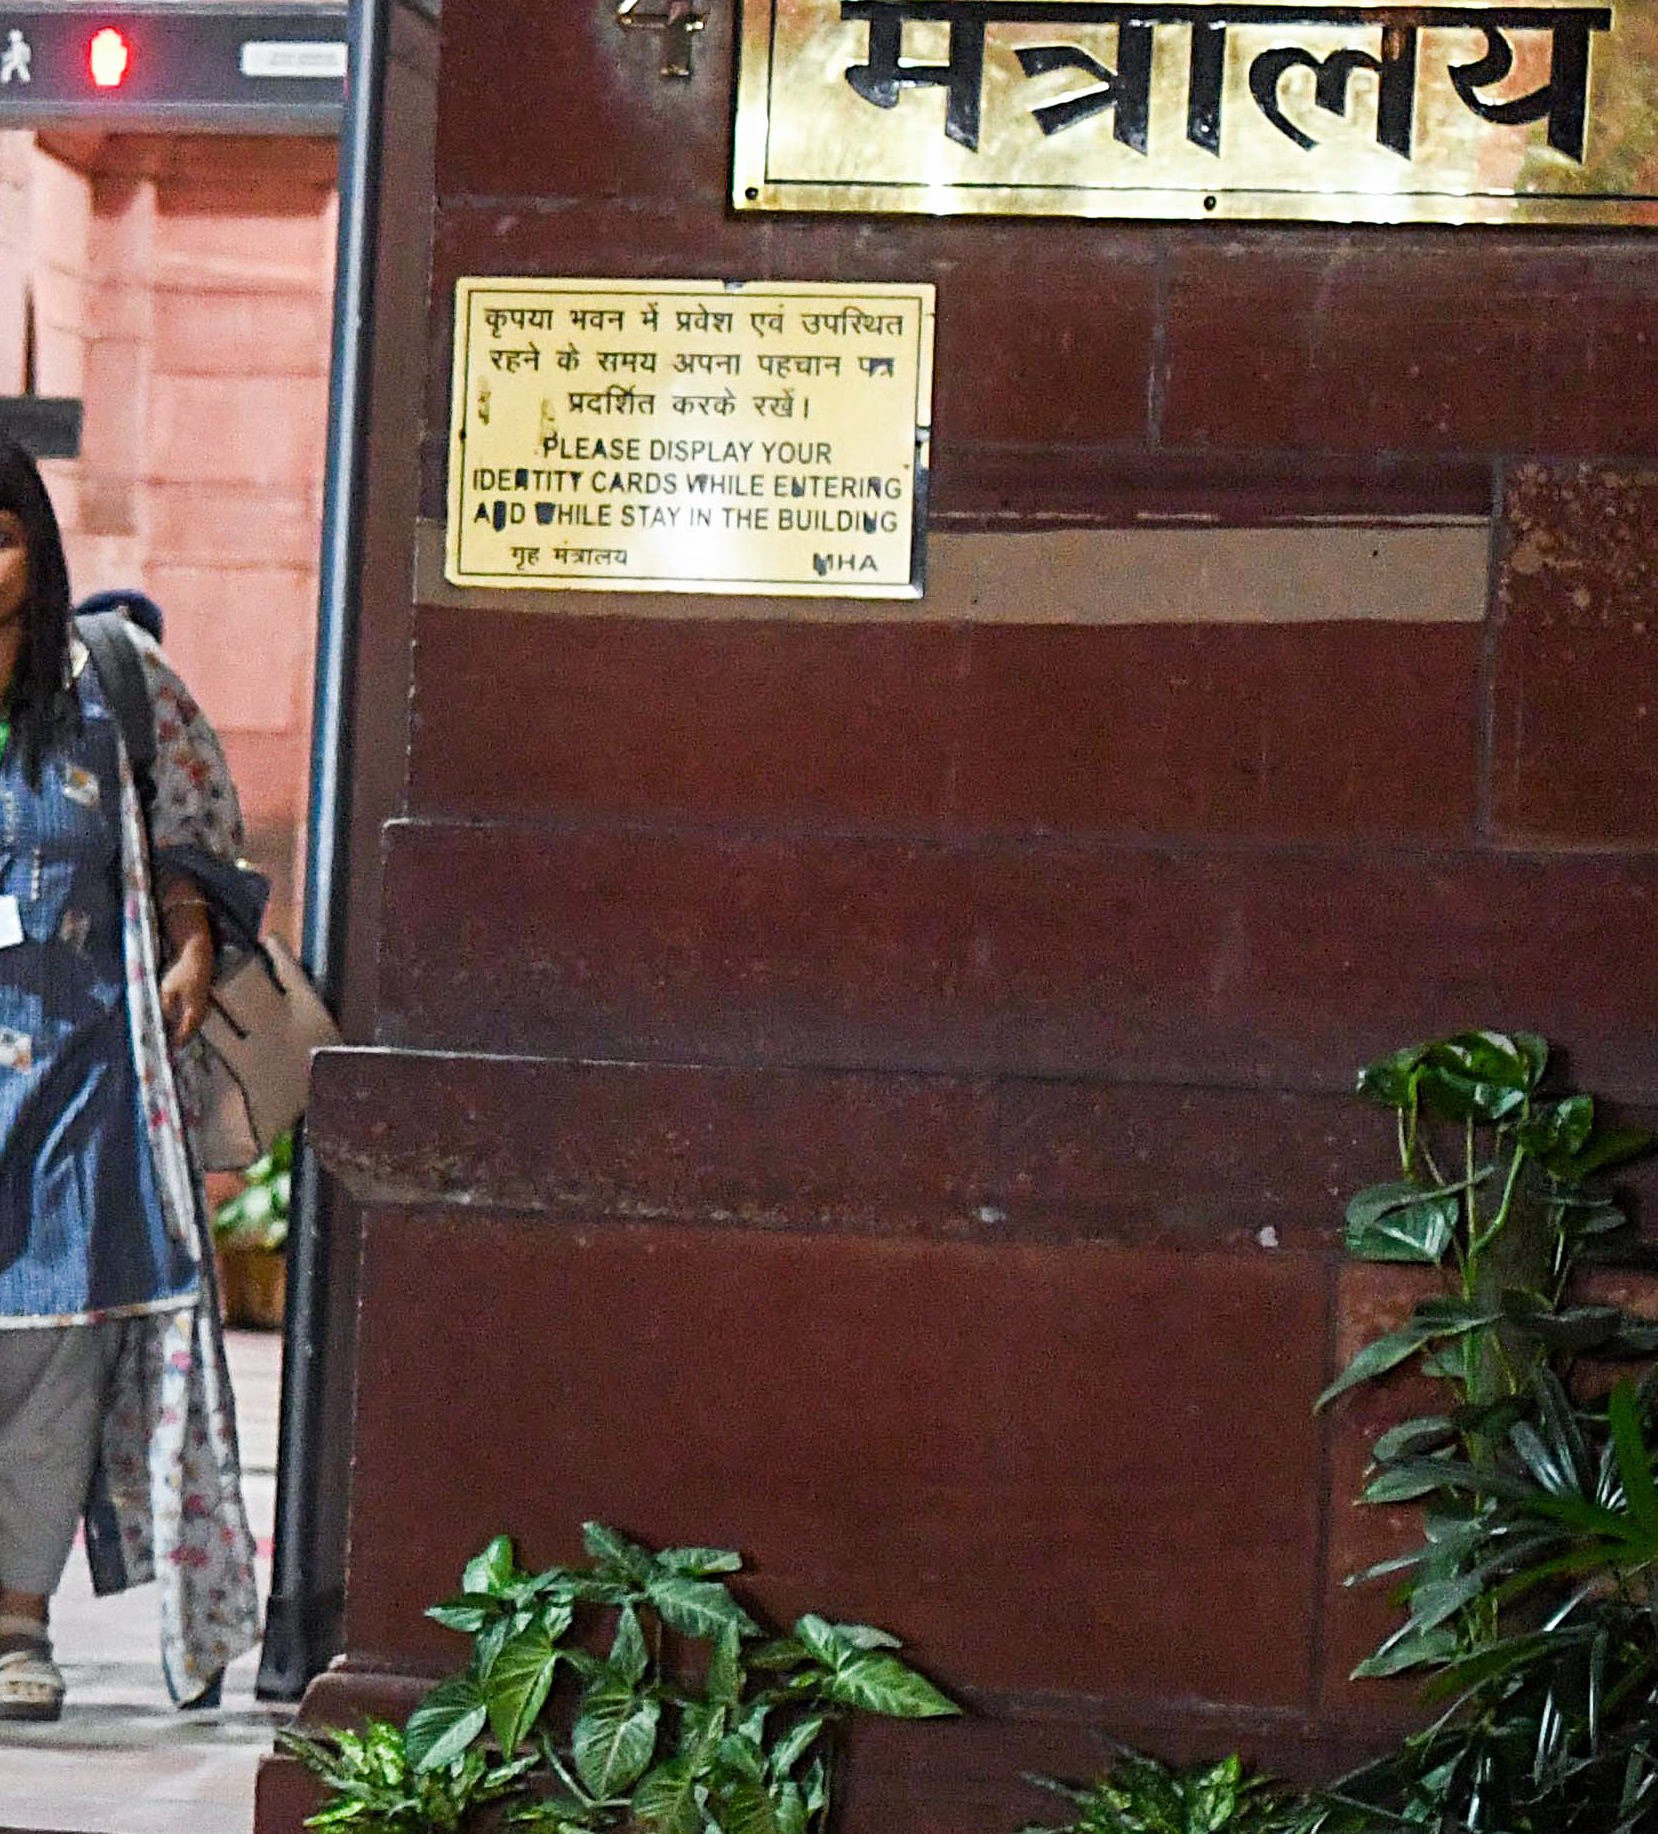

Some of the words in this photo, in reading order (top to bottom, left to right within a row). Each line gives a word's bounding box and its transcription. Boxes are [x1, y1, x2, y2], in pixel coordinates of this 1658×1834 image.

[484, 308, 553, 338] कृपया
[570, 310, 625, 331] भवन
[641, 302, 659, 331] में
[675, 303, 733, 333] प्रवेश
[750, 304, 783, 337] एवं
[800, 306, 903, 336] उपस्थित
[490, 342, 540, 372] रहने
[556, 342, 580, 371] के
[597, 352, 657, 373] समय
[673, 354, 740, 375] अपना
[757, 354, 841, 378] पहचान
[568, 383, 655, 414] प्रदर्शित
[672, 387, 736, 416] करके
[543, 436, 640, 461] PLEASE
[650, 439, 753, 462] DISPLAY
[762, 441, 832, 465] YOUR
[592, 470, 677, 494] CARDS
[686, 473, 764, 496] WHILE
[774, 476, 902, 499] ENTERING
[474, 501, 525, 529] AD
[535, 501, 611, 526] HILE
[621, 504, 681, 527] STAY
[690, 507, 711, 527] IN
[722, 507, 768, 530] THE
[778, 509, 898, 533] BUILDING
[510, 546, 540, 570] गृह
[553, 541, 627, 565] मंत्रालय
[813, 553, 878, 575] MHA
